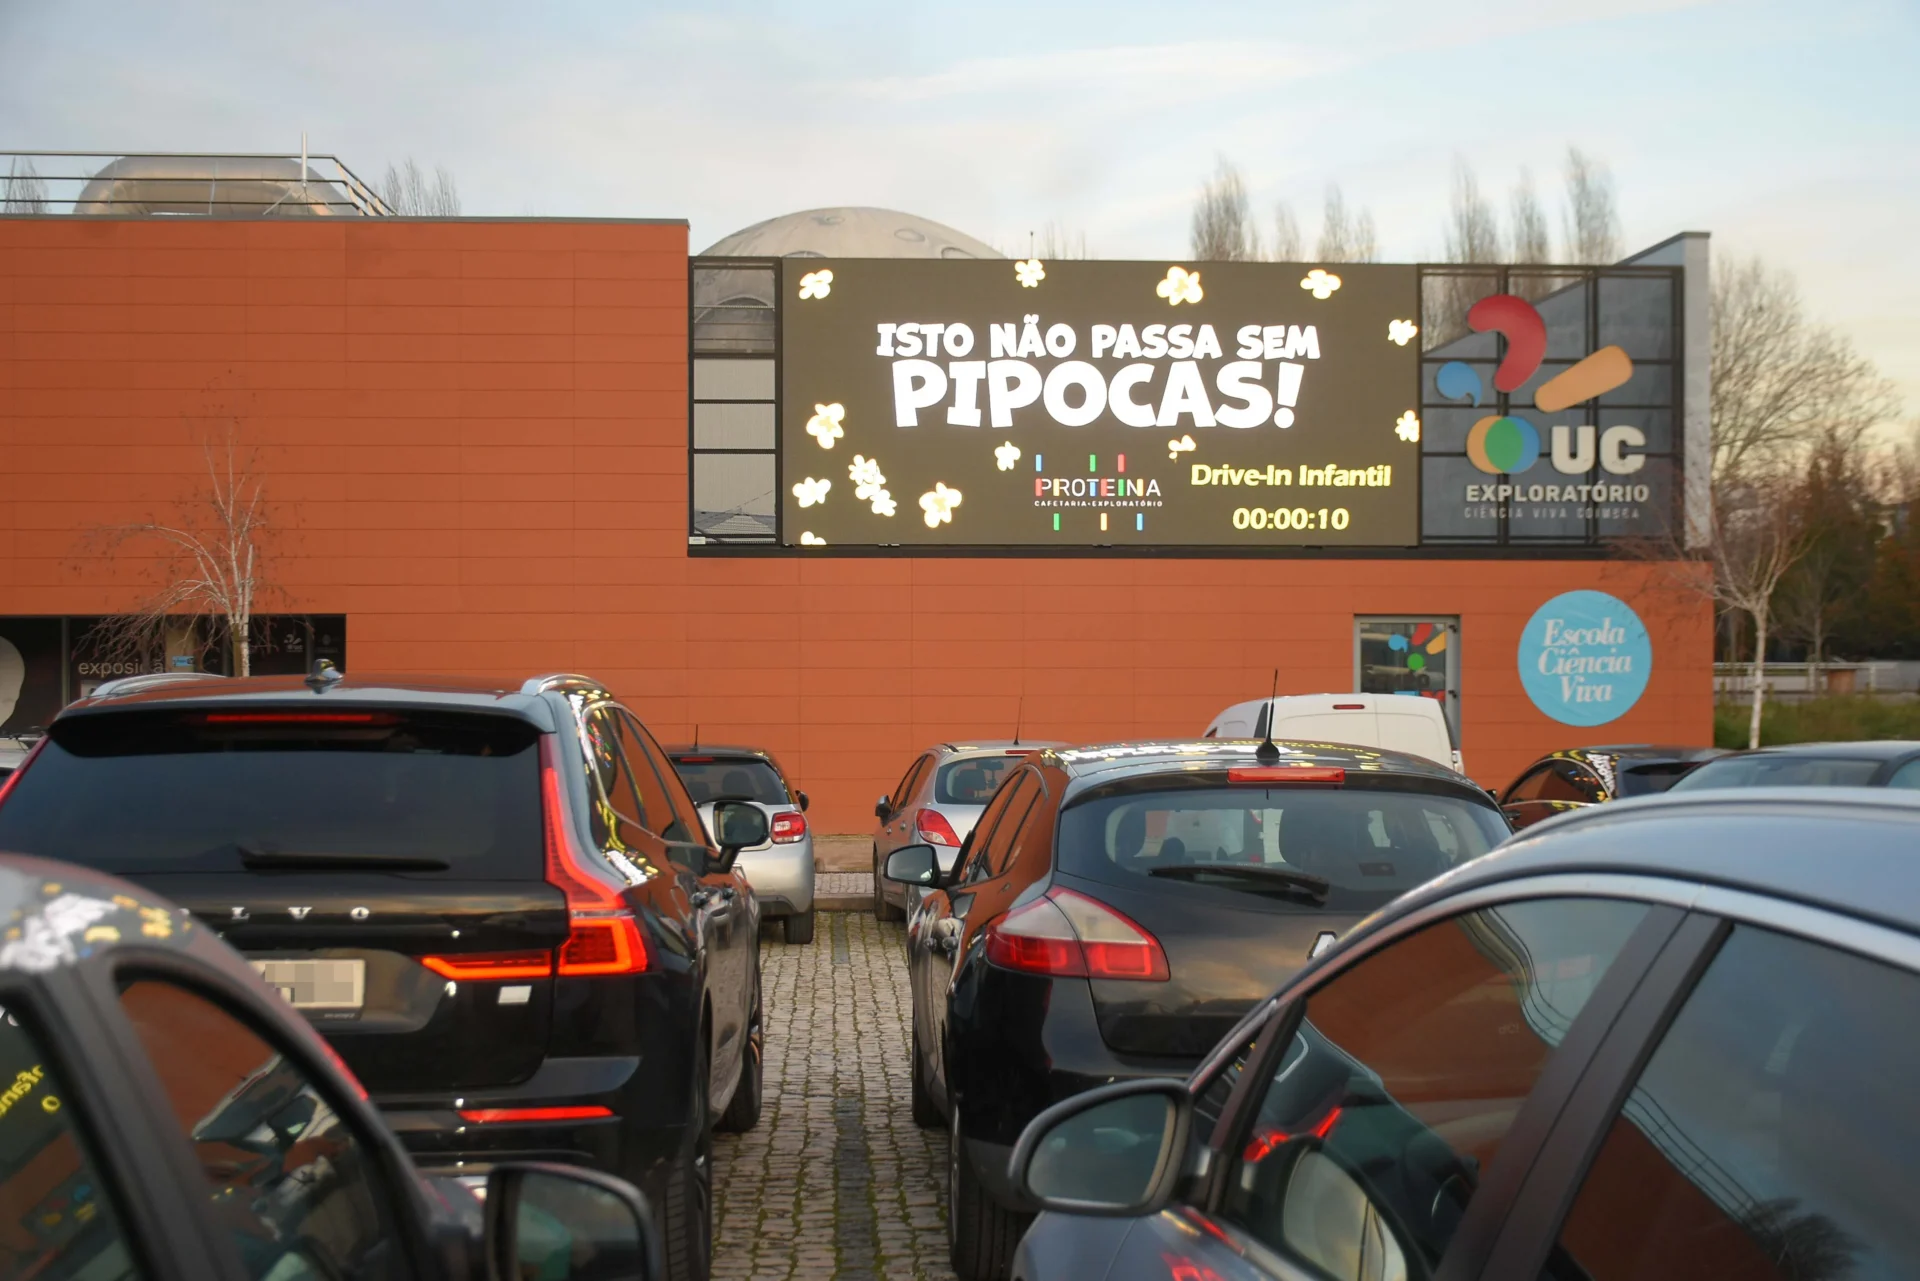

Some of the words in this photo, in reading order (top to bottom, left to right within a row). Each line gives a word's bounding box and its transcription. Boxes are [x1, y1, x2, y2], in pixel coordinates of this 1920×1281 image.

[876, 322, 974, 358] ISTO
[989, 313, 1077, 358] NÃO
[1091, 323, 1223, 359] PASSA
[1236, 324, 1321, 360] SEM
[891, 358, 1305, 429] PIPOCAS!
[1551, 425, 1646, 475] UC
[1191, 464, 1292, 486] Drive-In
[1299, 464, 1391, 487] Infantil
[1465, 480, 1650, 503] EXPLORATÓRIO
[1232, 507, 1350, 530] 00:00:10
[1464, 504, 1523, 519] CIÊNCIA
[1532, 506, 1567, 519] VIVA
[1543, 617, 1625, 646] Escola
[1538, 647, 1632, 675] Ciência
[1560, 675, 1613, 702] Viva
